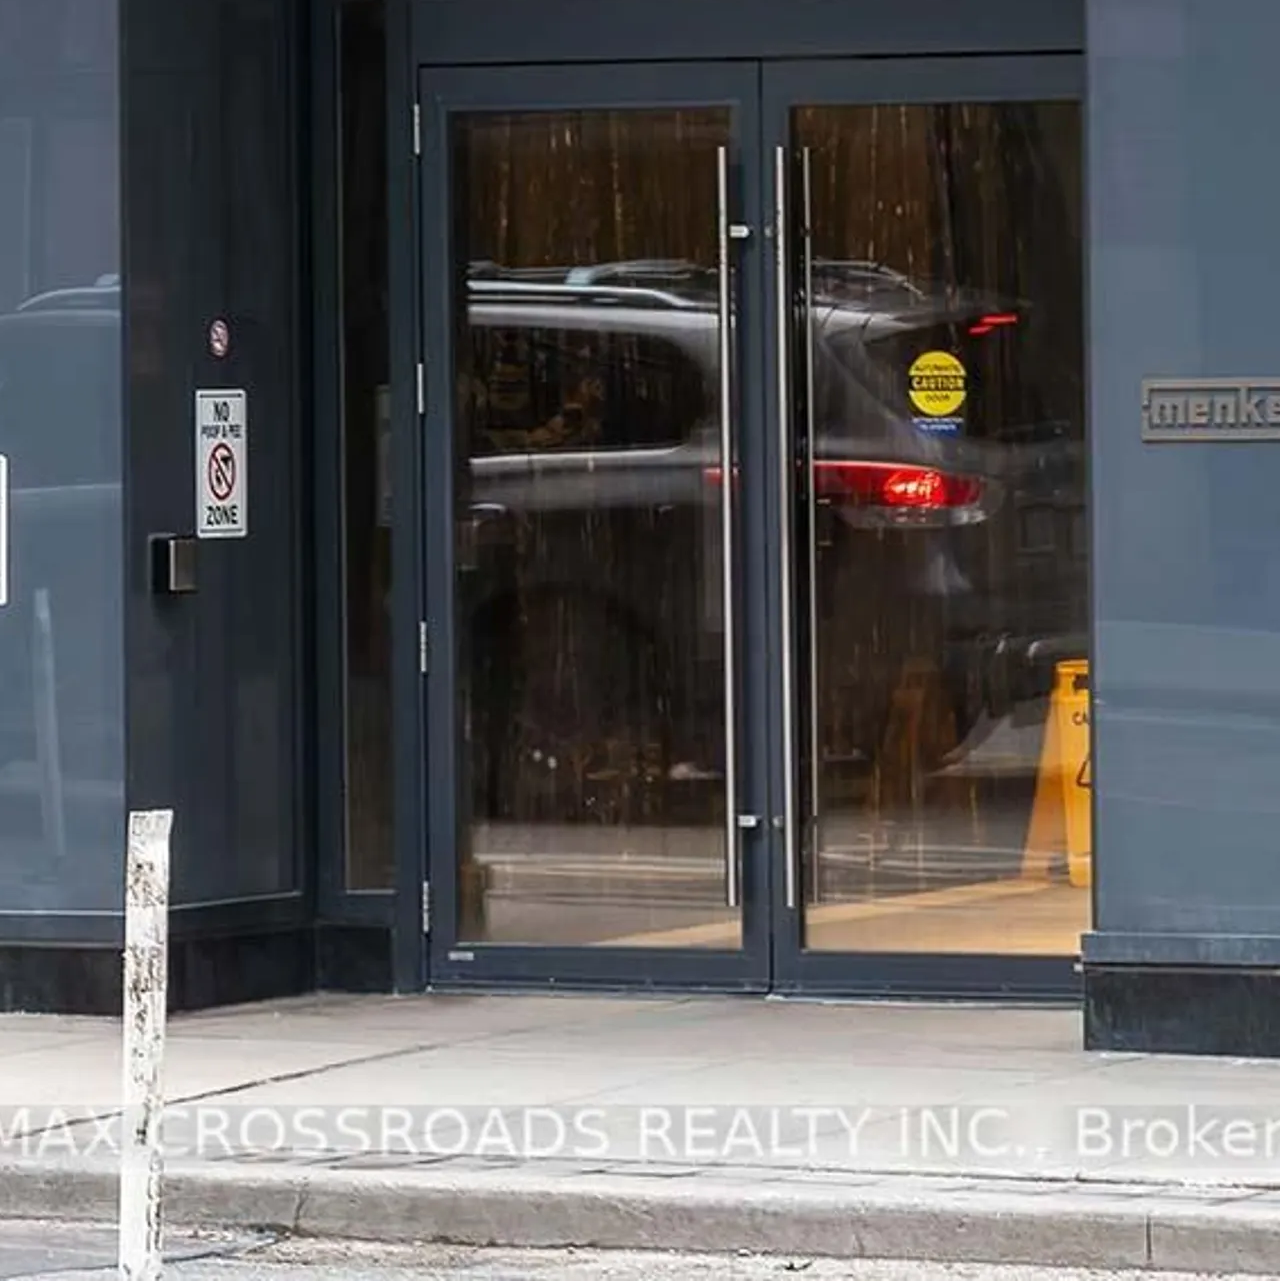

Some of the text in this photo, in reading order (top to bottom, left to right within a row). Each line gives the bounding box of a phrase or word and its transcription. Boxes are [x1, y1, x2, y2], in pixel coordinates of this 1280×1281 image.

[911, 375, 965, 390] CAUTION
[212, 400, 230, 422] NO
[206, 504, 239, 526] ZONE
